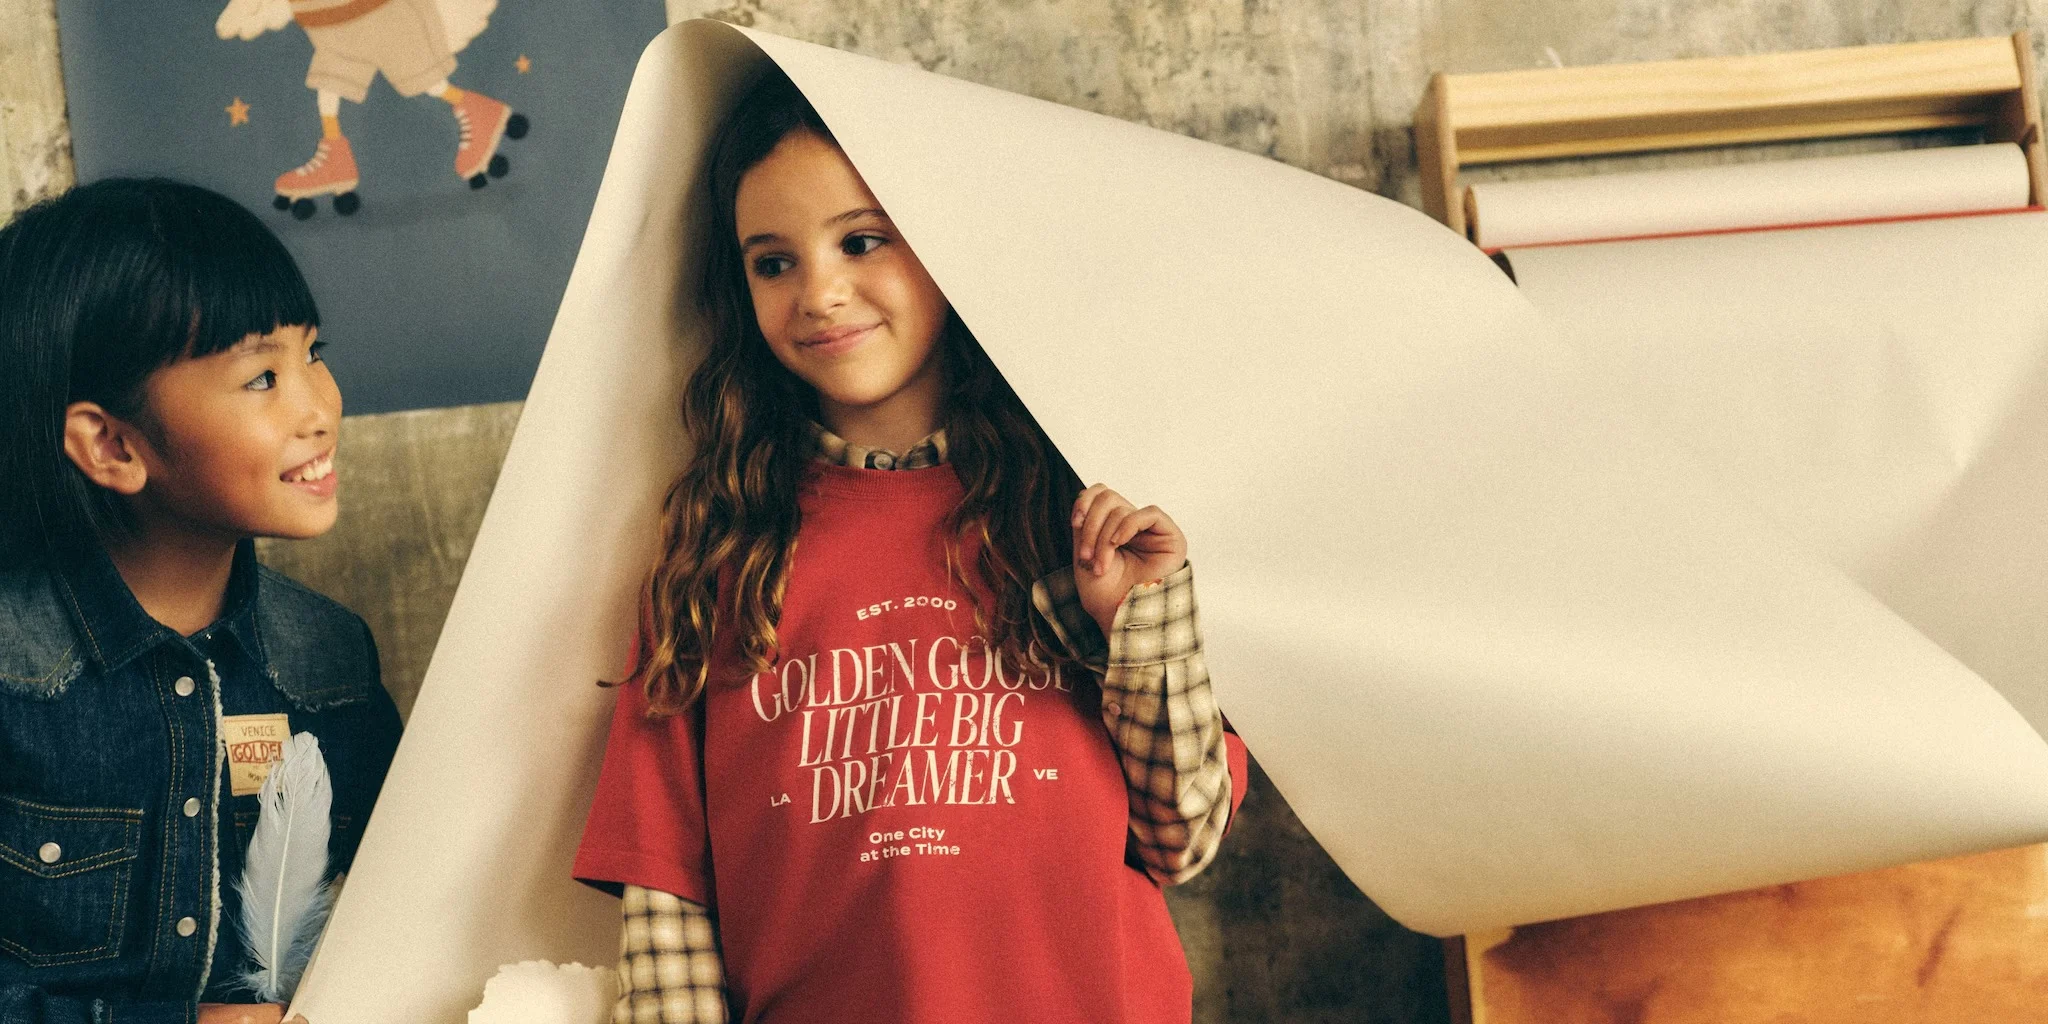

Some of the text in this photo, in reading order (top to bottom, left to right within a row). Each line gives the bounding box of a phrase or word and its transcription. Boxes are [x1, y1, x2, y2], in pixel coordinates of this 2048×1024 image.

[856, 595, 957, 621] EST. 2000
[751, 638, 920, 723] GOLDEN
[241, 725, 276, 737] VENICE
[797, 692, 1025, 768] LITTLE BIG
[1033, 768, 1058, 780] VE
[809, 749, 1017, 824] DREAMER
[770, 793, 791, 807] LA
[869, 826, 946, 845] One City
[860, 843, 961, 863] at the Time
